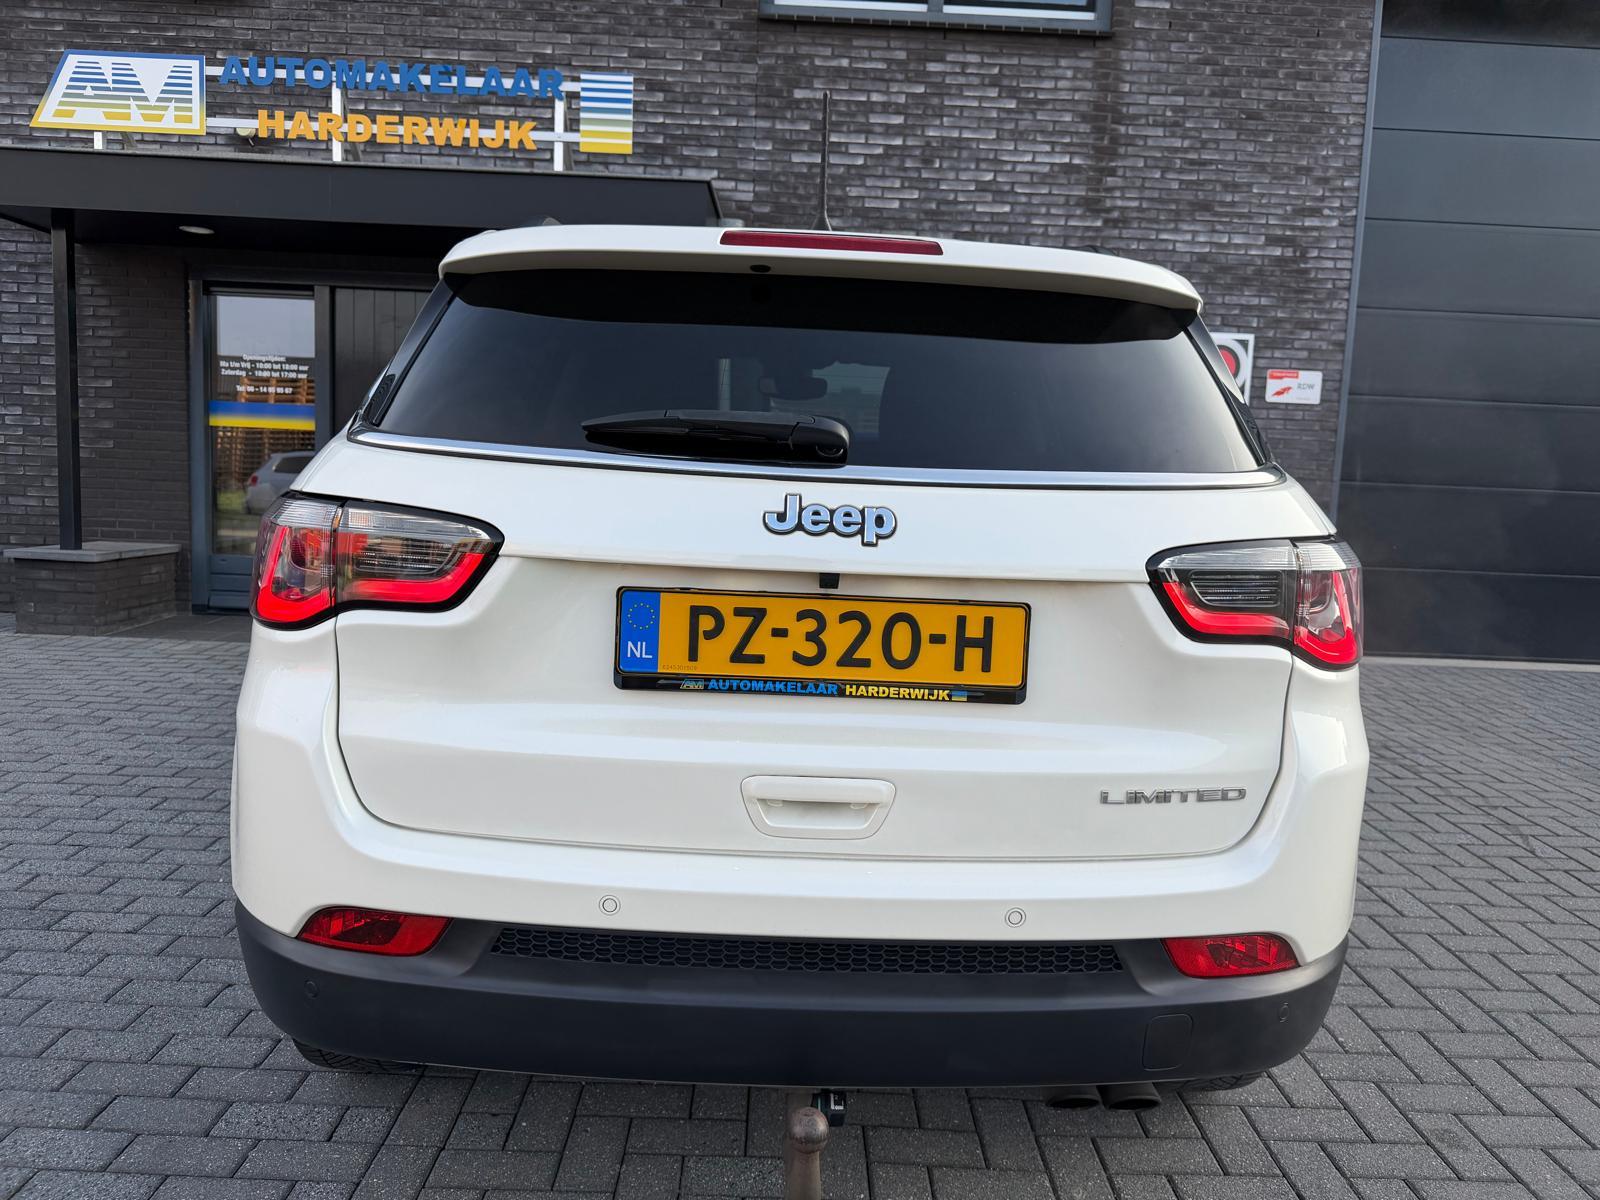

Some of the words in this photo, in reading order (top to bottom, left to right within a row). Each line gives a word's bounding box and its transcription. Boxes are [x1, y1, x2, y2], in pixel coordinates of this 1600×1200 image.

[52, 60, 194, 124] AM
[218, 56, 564, 99] AUTOMAKELAAR
[256, 109, 538, 150] HARDERWIJK
[763, 493, 897, 547] Jeep
[627, 641, 653, 659] NL
[687, 604, 995, 673] PZ-320-H
[708, 678, 838, 695] AUTOMAKELAAR
[845, 685, 950, 701] HARDERWIJK
[1100, 788, 1247, 805] LIMITED
